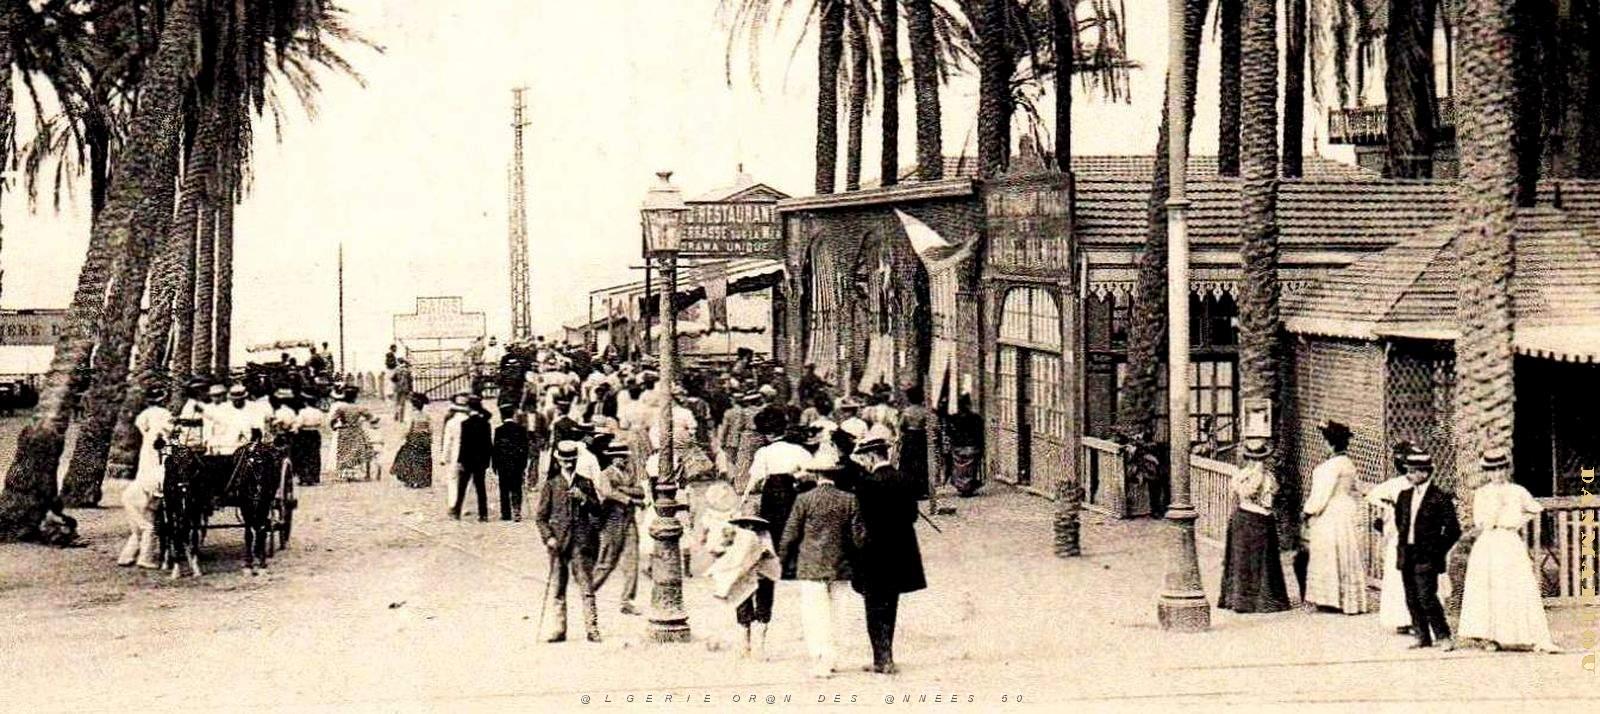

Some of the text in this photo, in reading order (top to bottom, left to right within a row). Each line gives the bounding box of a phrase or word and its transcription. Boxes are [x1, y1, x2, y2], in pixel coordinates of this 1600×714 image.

[697, 205, 776, 223] RESTAURANT
[682, 224, 728, 239] ERRASSE
[726, 241, 769, 253] UNIQUE
